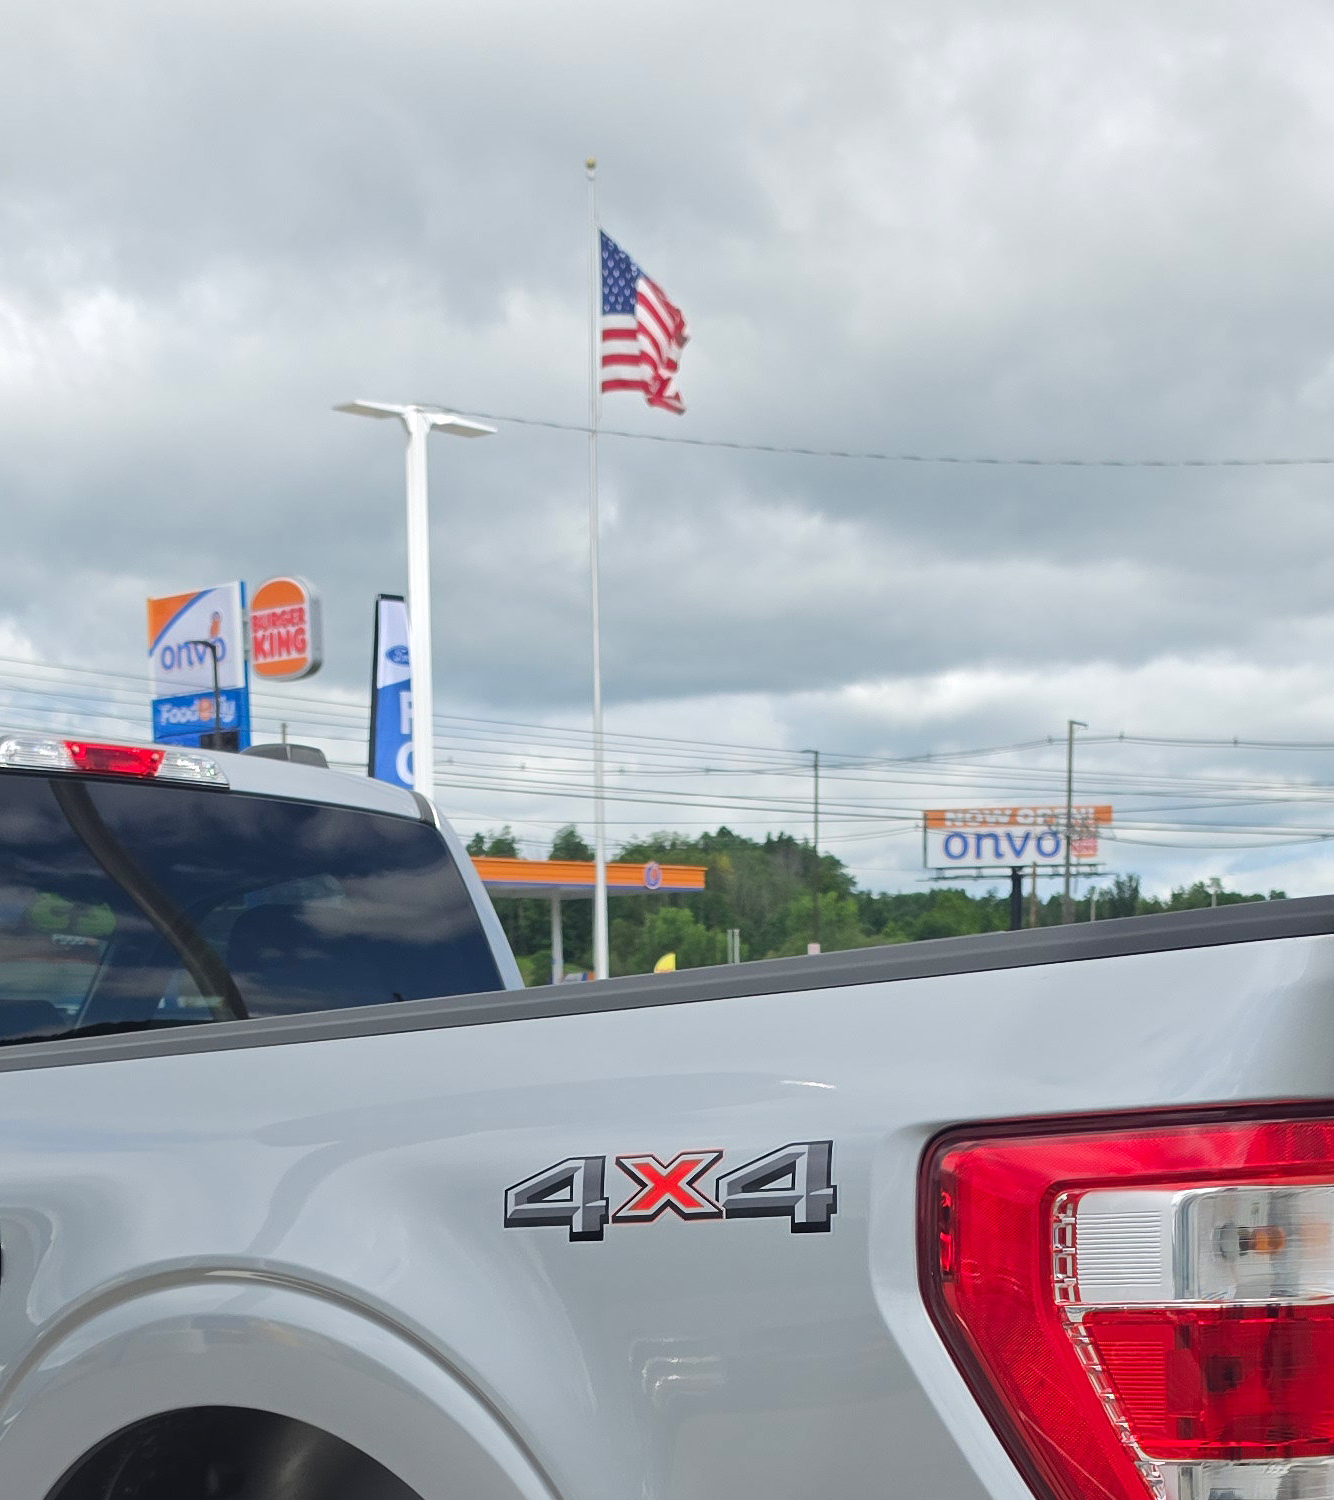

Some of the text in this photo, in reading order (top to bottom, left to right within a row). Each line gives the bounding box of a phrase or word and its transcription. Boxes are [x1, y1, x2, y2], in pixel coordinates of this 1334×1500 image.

[252, 607, 306, 633] BURGER
[161, 637, 226, 671] onvo
[253, 628, 307, 660] KING
[944, 831, 1061, 859] onvo
